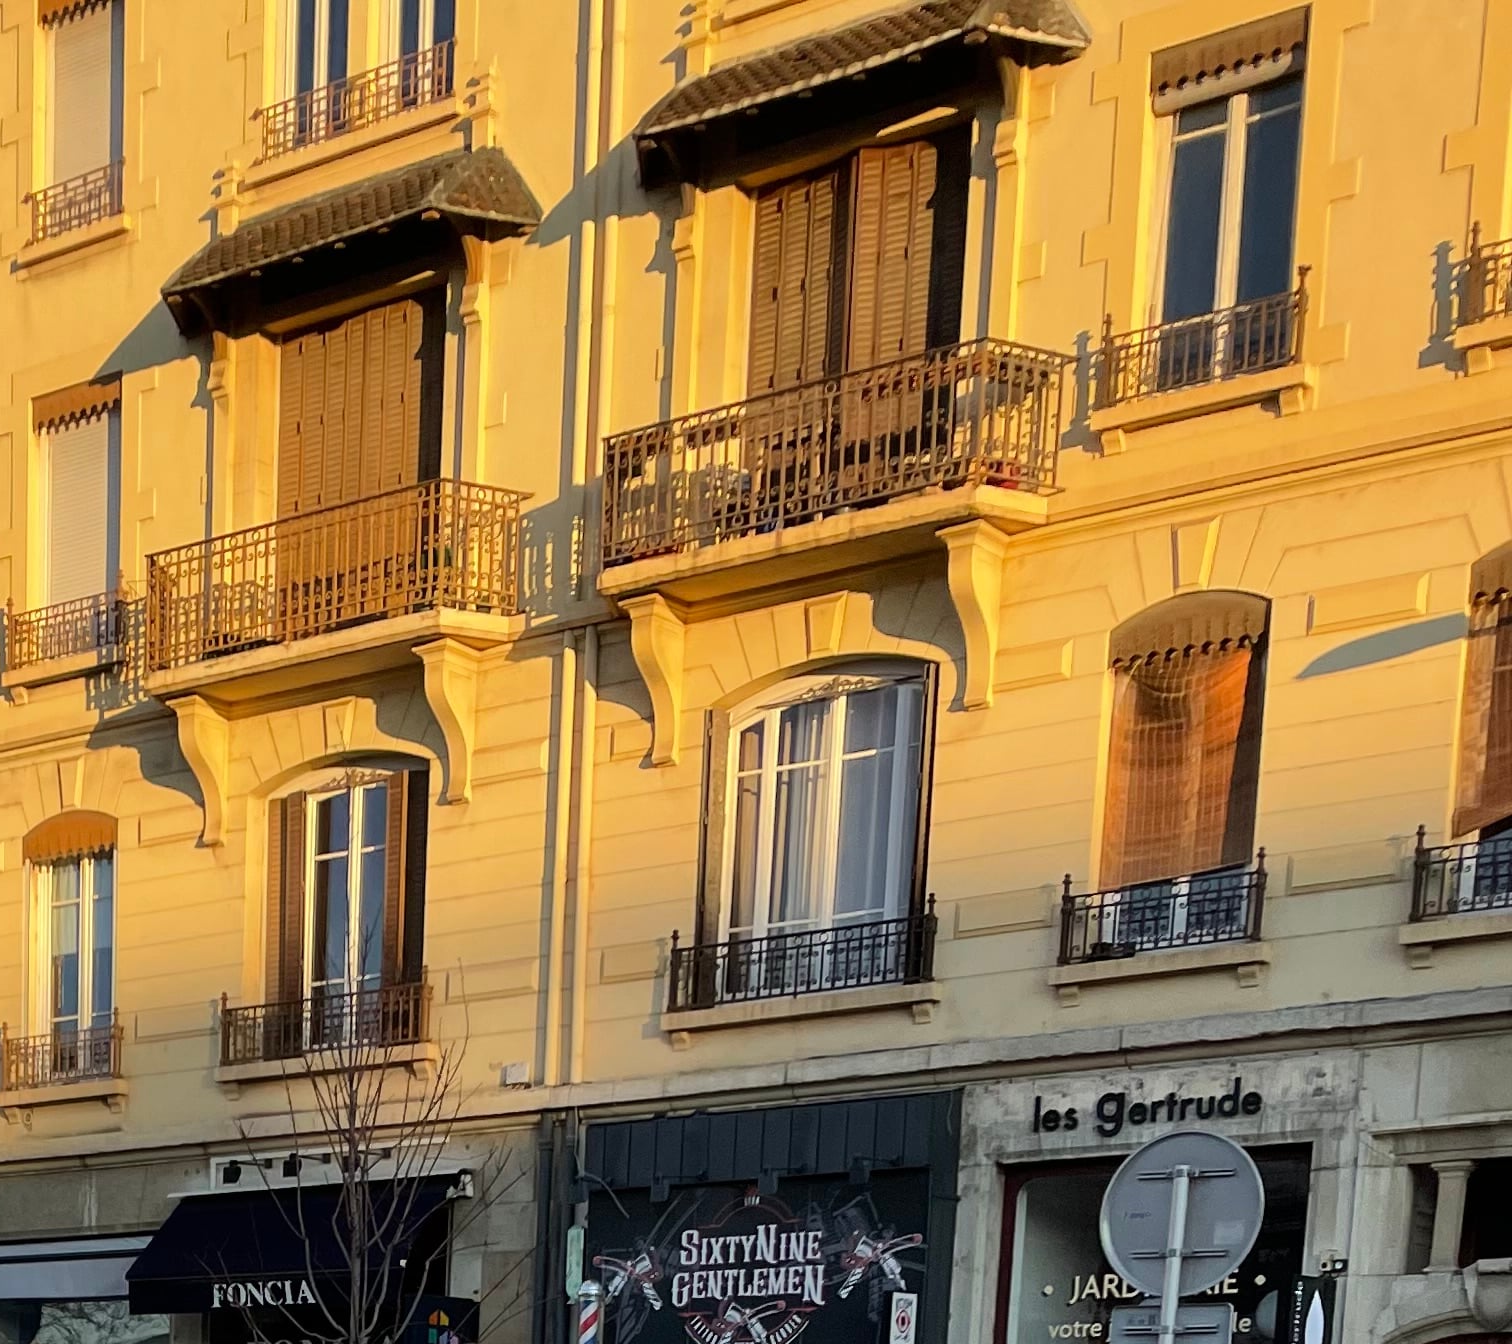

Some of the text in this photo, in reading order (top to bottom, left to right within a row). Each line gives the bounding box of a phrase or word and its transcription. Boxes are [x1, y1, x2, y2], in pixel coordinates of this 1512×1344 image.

[1033, 1095, 1078, 1133] les
[211, 1279, 317, 1308] FONCIA
[1048, 1321, 1103, 1340] votre
